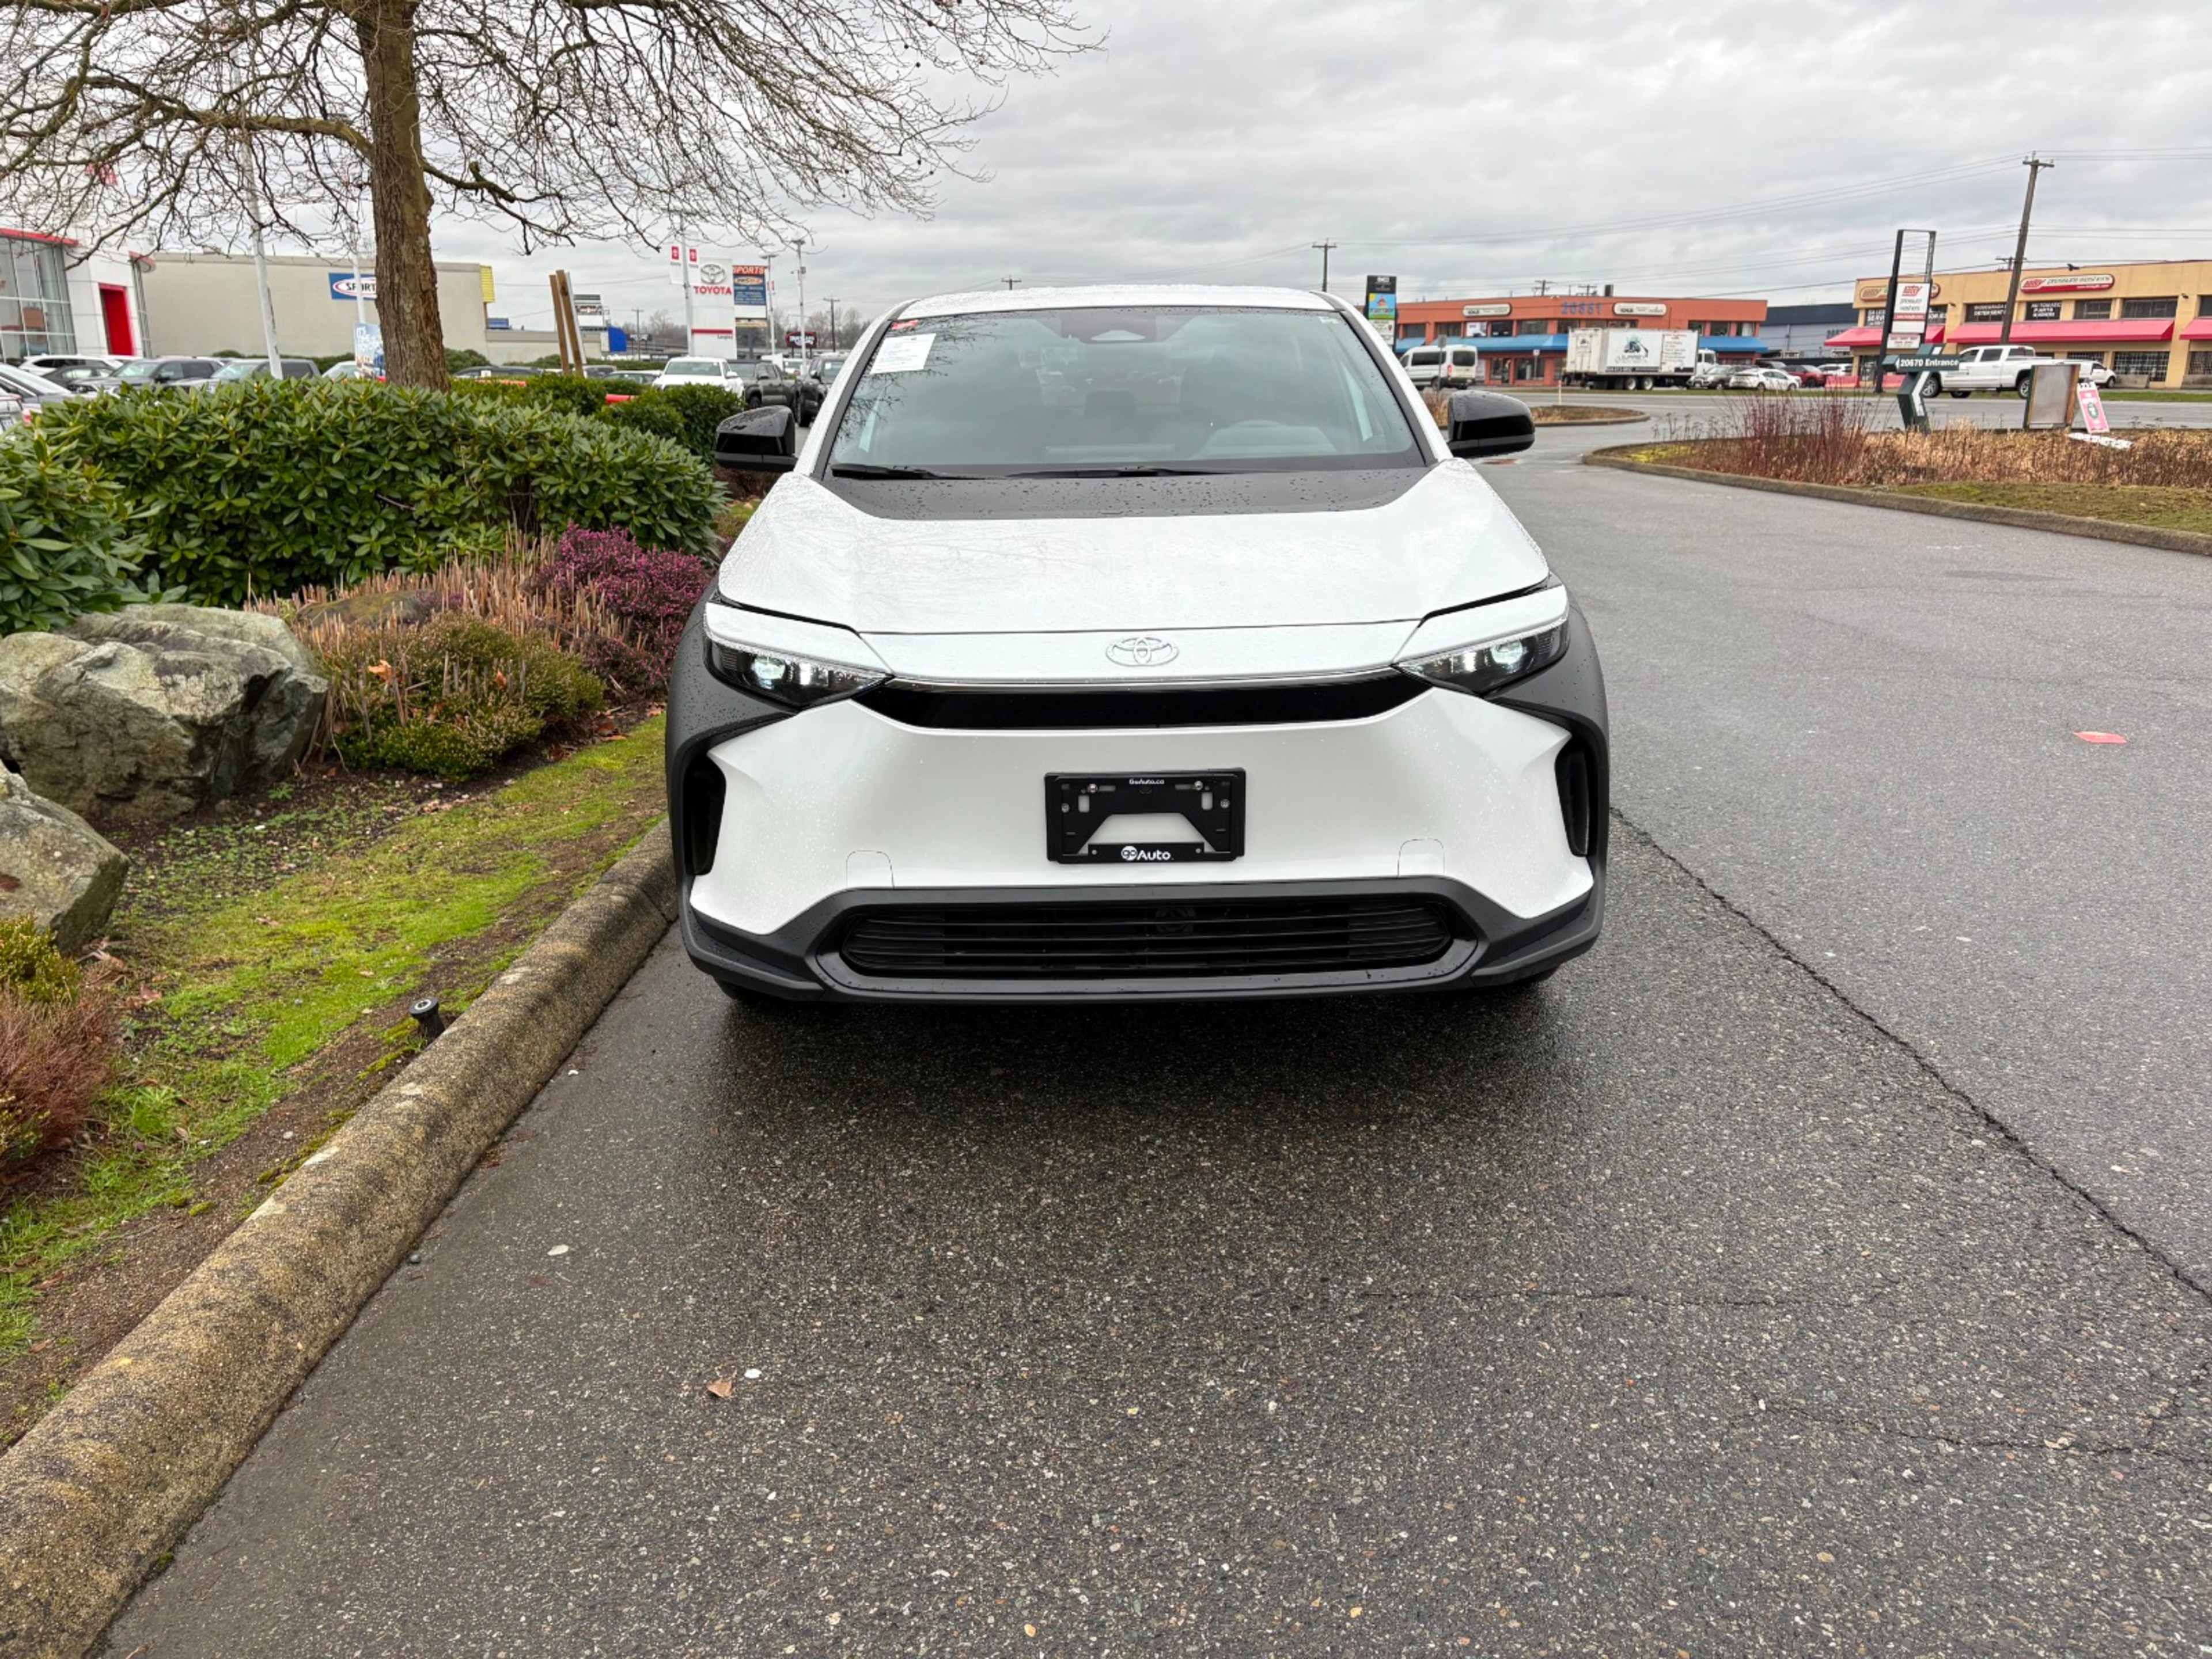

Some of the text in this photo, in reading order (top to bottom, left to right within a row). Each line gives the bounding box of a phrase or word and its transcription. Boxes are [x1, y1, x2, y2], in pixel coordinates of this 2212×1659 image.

[346, 282, 376, 291] SPRT
[694, 286, 732, 295] TOYOTA
[1901, 358, 1959, 367] 20670 Entrance
